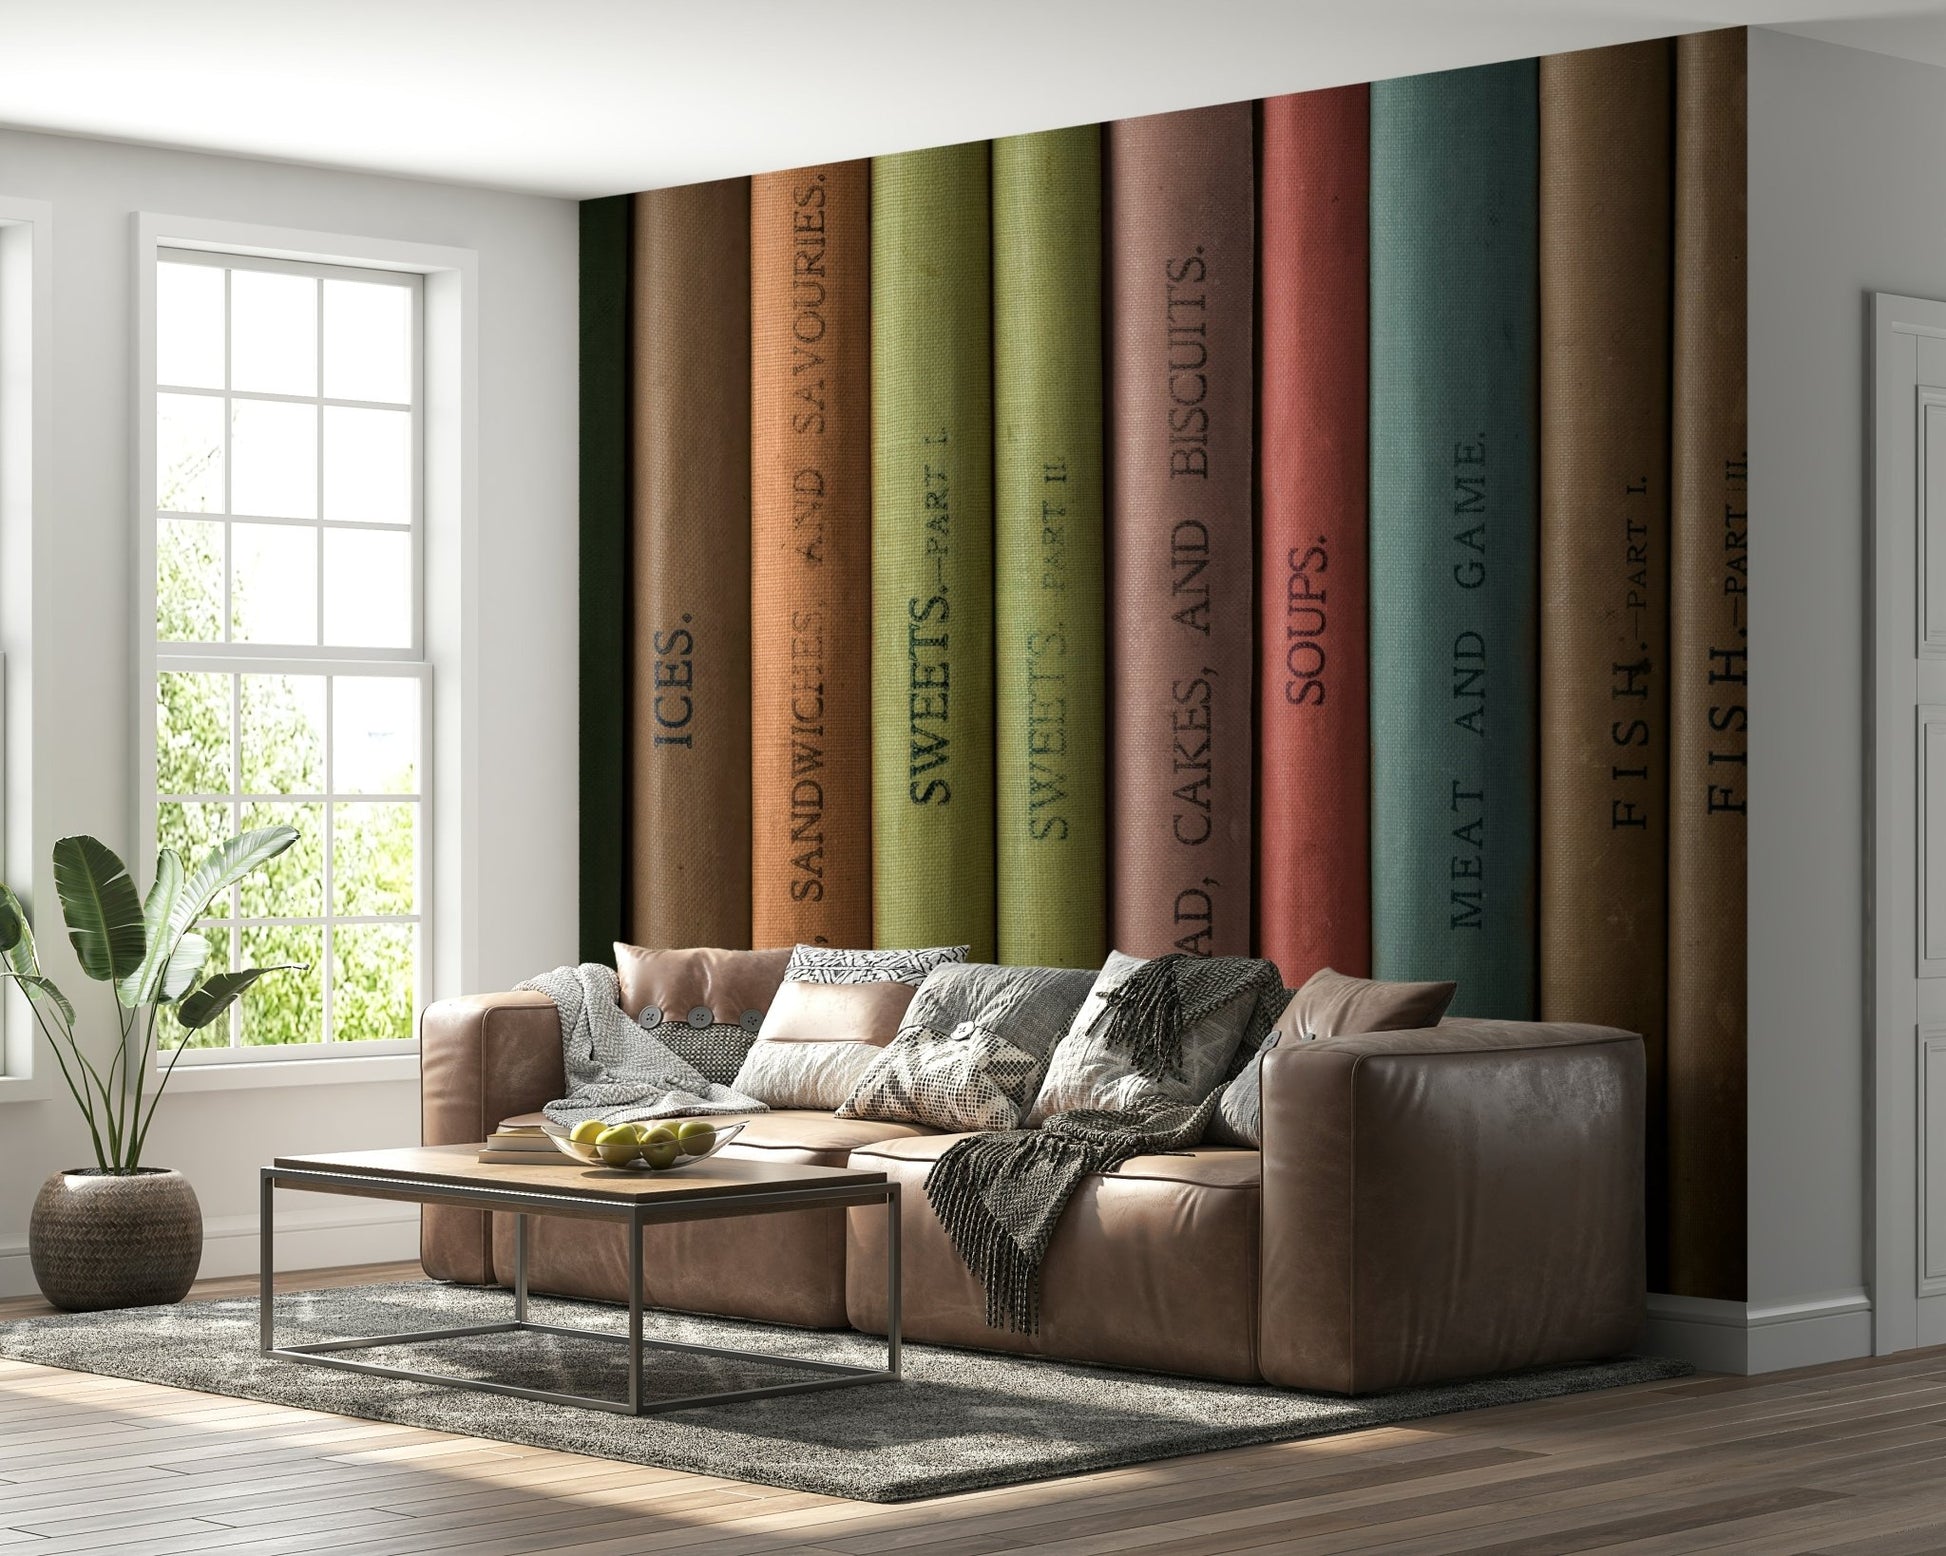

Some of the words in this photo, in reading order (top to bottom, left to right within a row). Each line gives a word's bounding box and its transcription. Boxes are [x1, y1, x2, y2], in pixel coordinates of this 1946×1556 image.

[793, 174, 826, 435] SAVOURIES.
[1166, 246, 1208, 480] BISCUITS.
[792, 466, 825, 567] AND
[1042, 501, 1066, 592] PART
[1171, 520, 1210, 637] AND
[1454, 432, 1486, 590] GAME.
[653, 613, 693, 750] ICES.
[1285, 536, 1328, 706] SOUPS.
[1454, 631, 1486, 738] AND
[1172, 667, 1218, 847] CAKES,
[1451, 780, 1484, 930] MEAT
